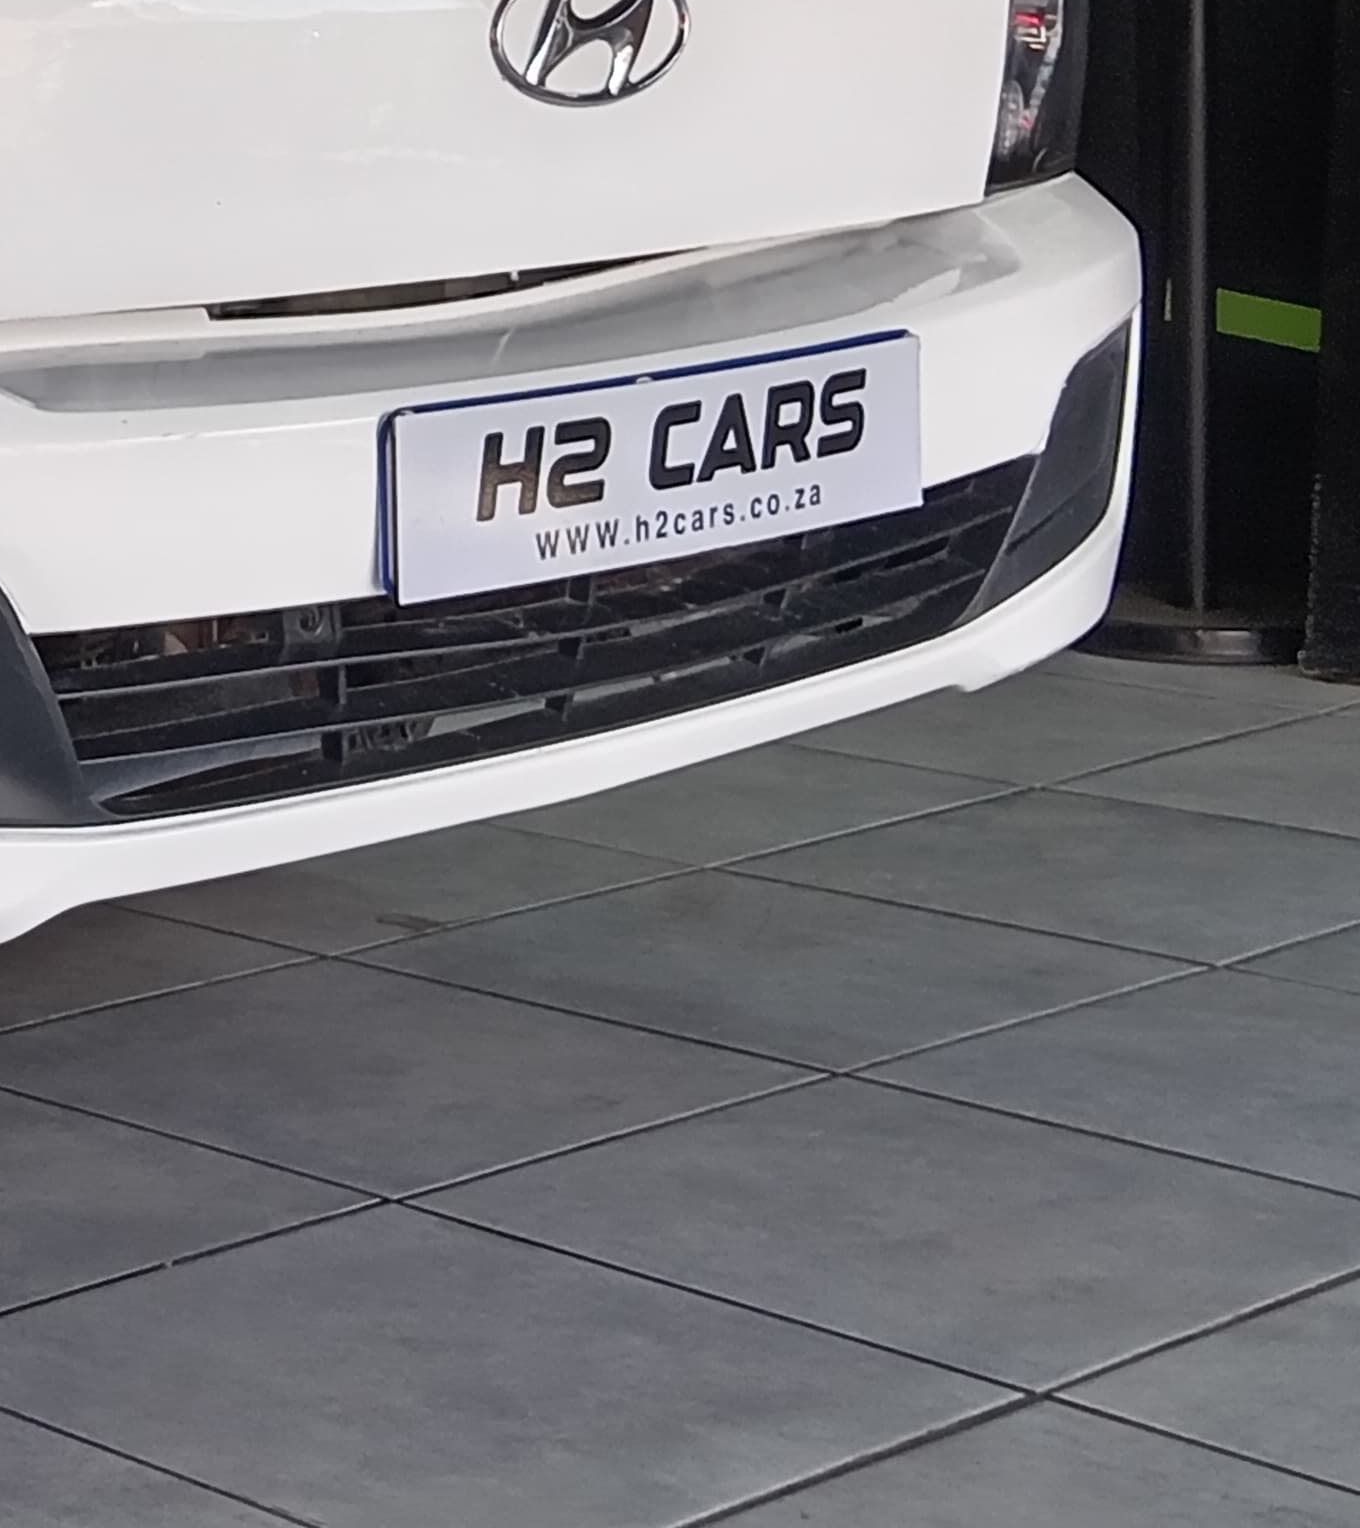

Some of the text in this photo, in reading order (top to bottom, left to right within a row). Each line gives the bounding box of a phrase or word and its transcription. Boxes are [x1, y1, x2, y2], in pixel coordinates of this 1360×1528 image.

[476, 368, 867, 522] H2 CARS
[535, 481, 823, 561] www.h2cars.co.za
